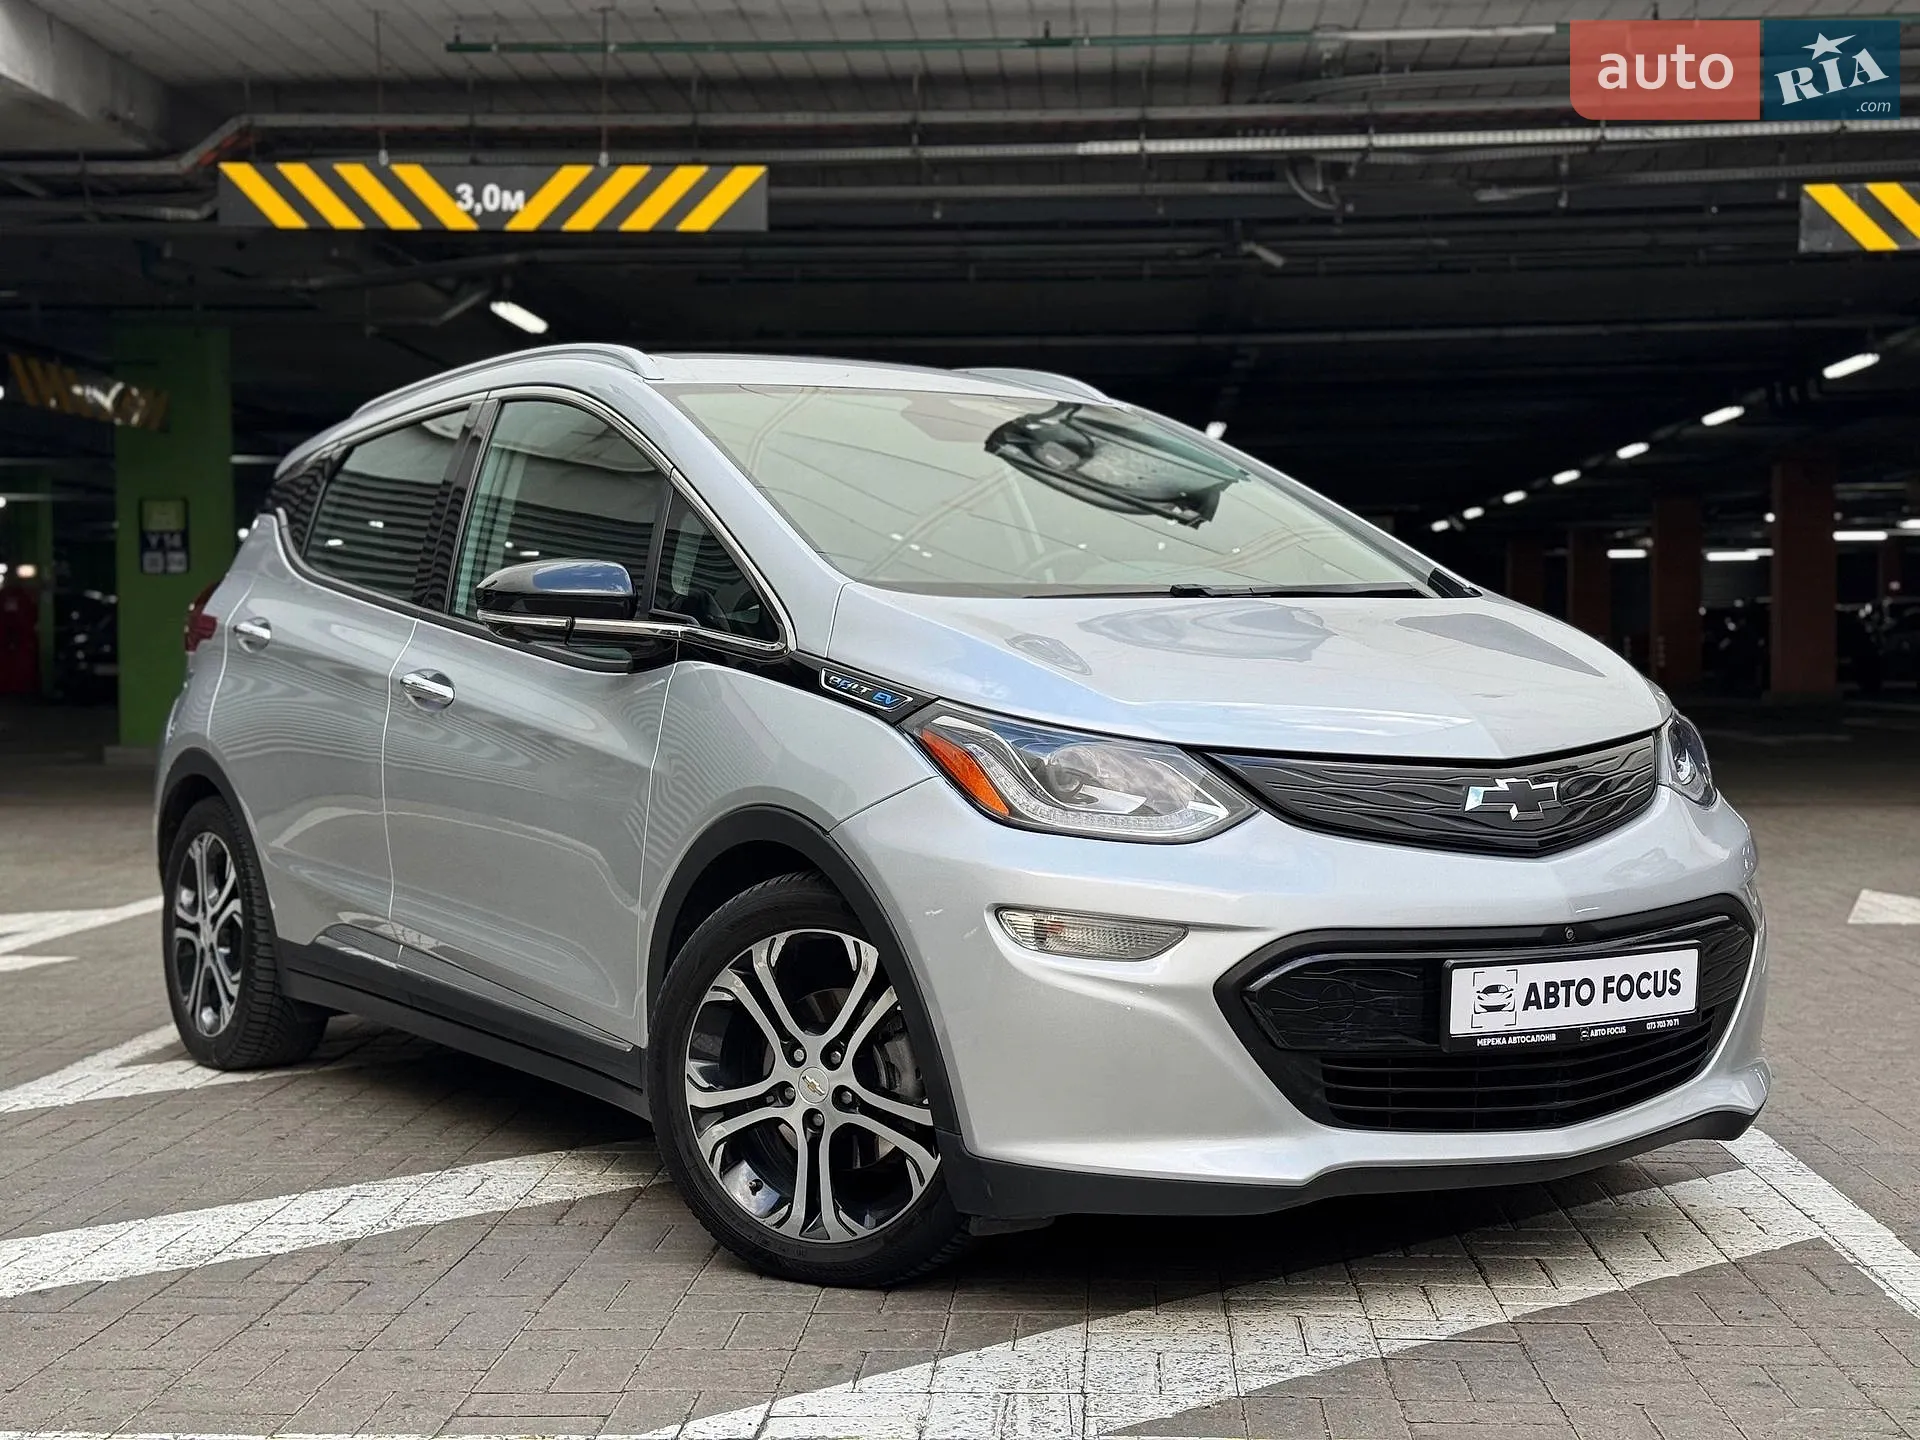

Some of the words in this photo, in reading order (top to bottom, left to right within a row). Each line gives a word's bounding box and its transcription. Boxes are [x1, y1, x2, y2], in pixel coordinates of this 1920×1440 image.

[873, 692, 900, 705] EV
[1522, 978, 1595, 1011] АВТО
[1602, 968, 1681, 1004] FOCUS
[1607, 1026, 1626, 1035] FOCUS
[1477, 1037, 1507, 1046] МЕРЕЖА
